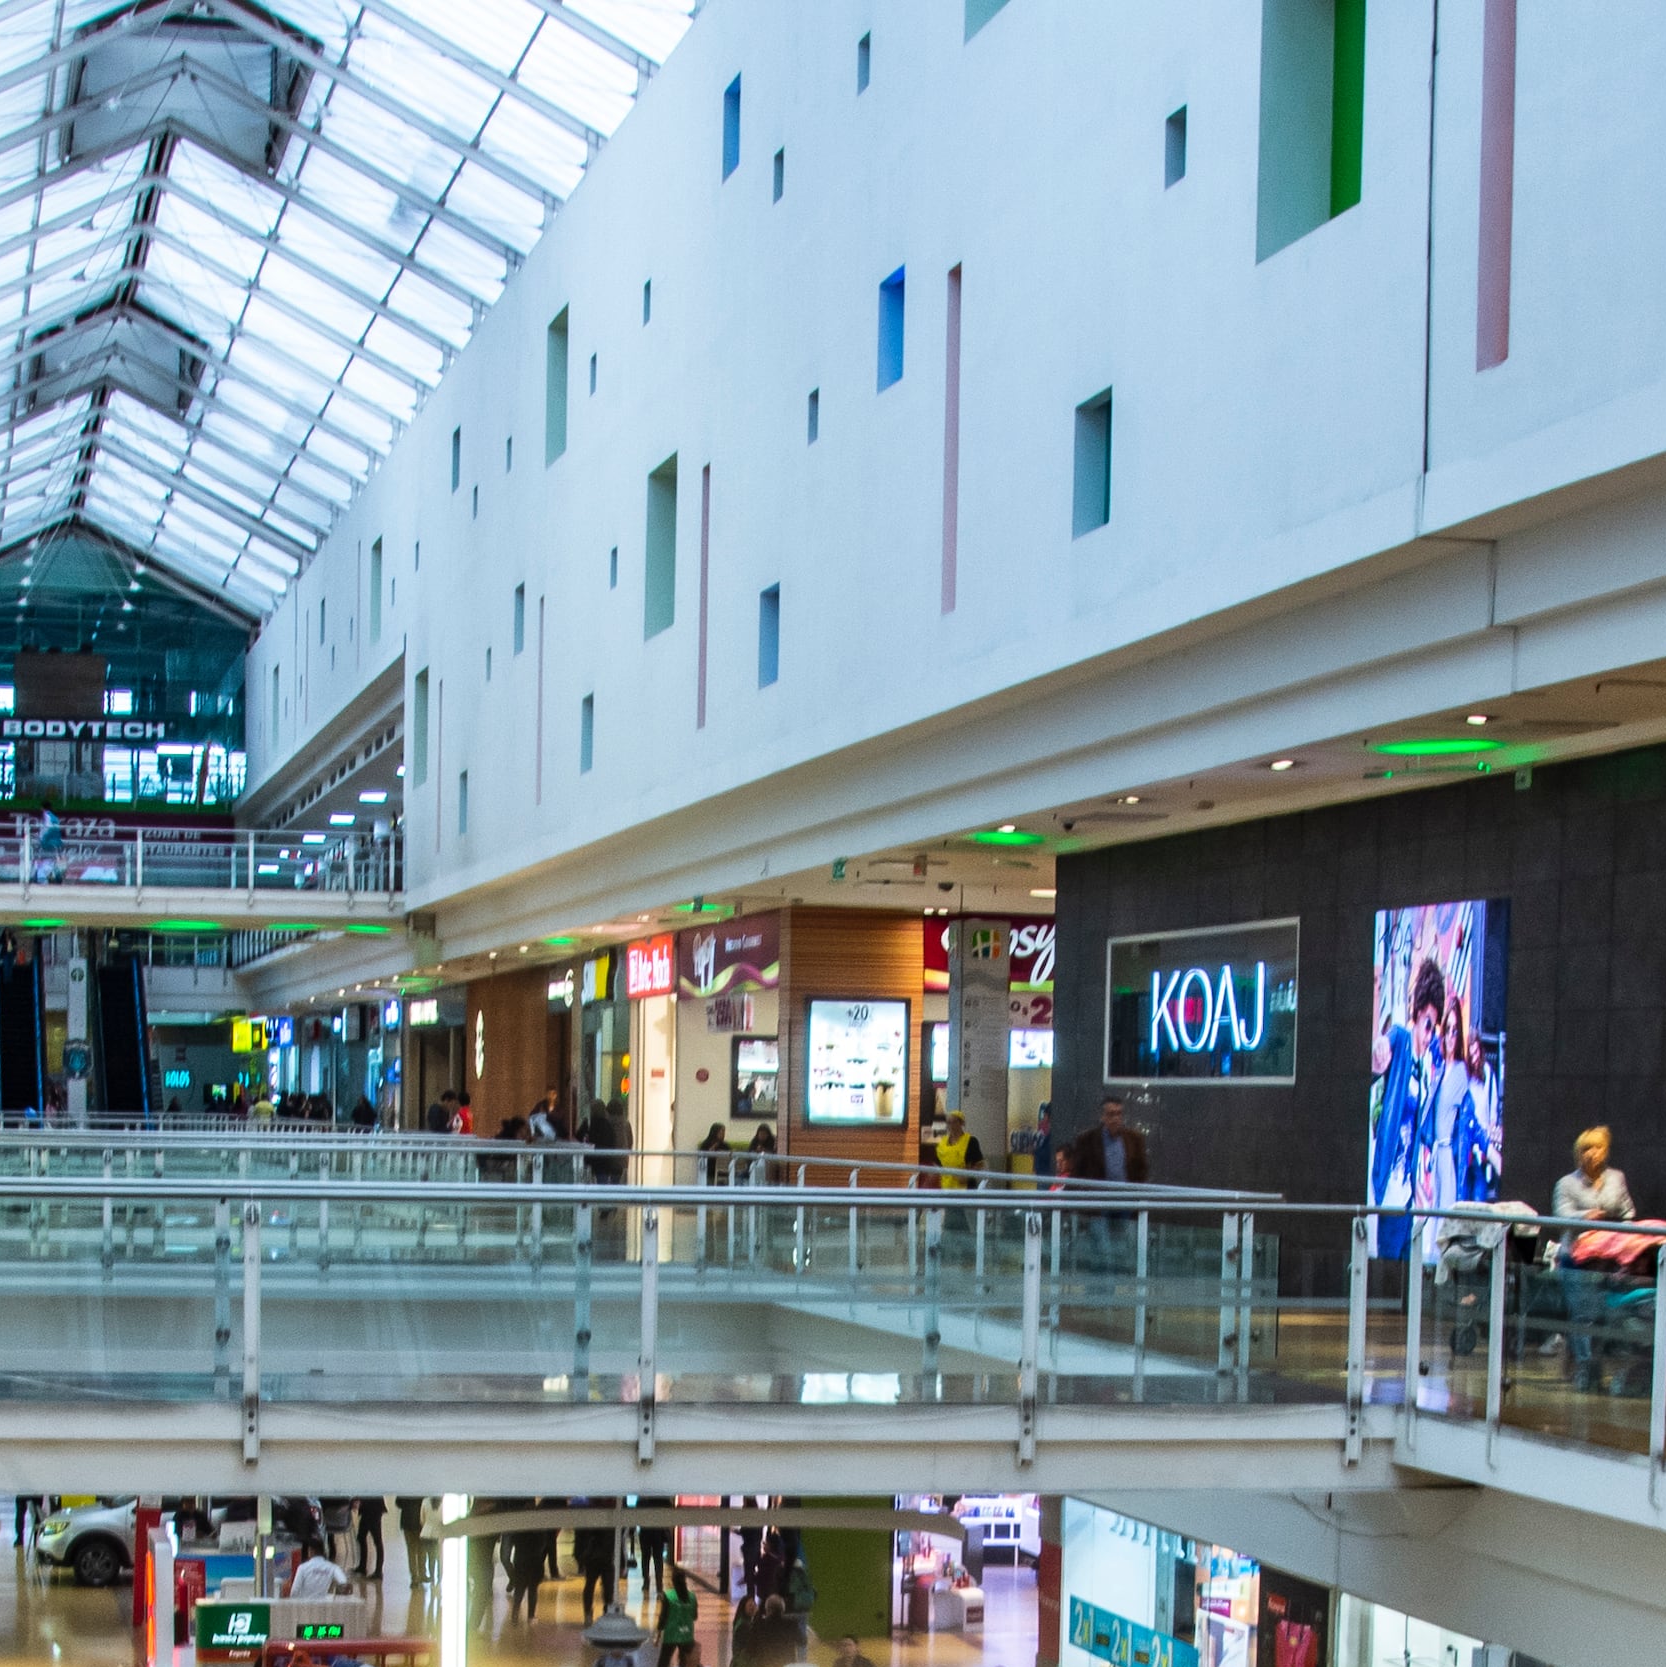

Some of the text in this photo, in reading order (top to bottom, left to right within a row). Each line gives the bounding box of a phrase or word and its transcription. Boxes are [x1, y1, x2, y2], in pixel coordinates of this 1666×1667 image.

[3, 719, 165, 739] BODYTECH
[1148, 959, 1268, 1053] KOAJ
[1073, 1601, 1095, 1649] 2x1
